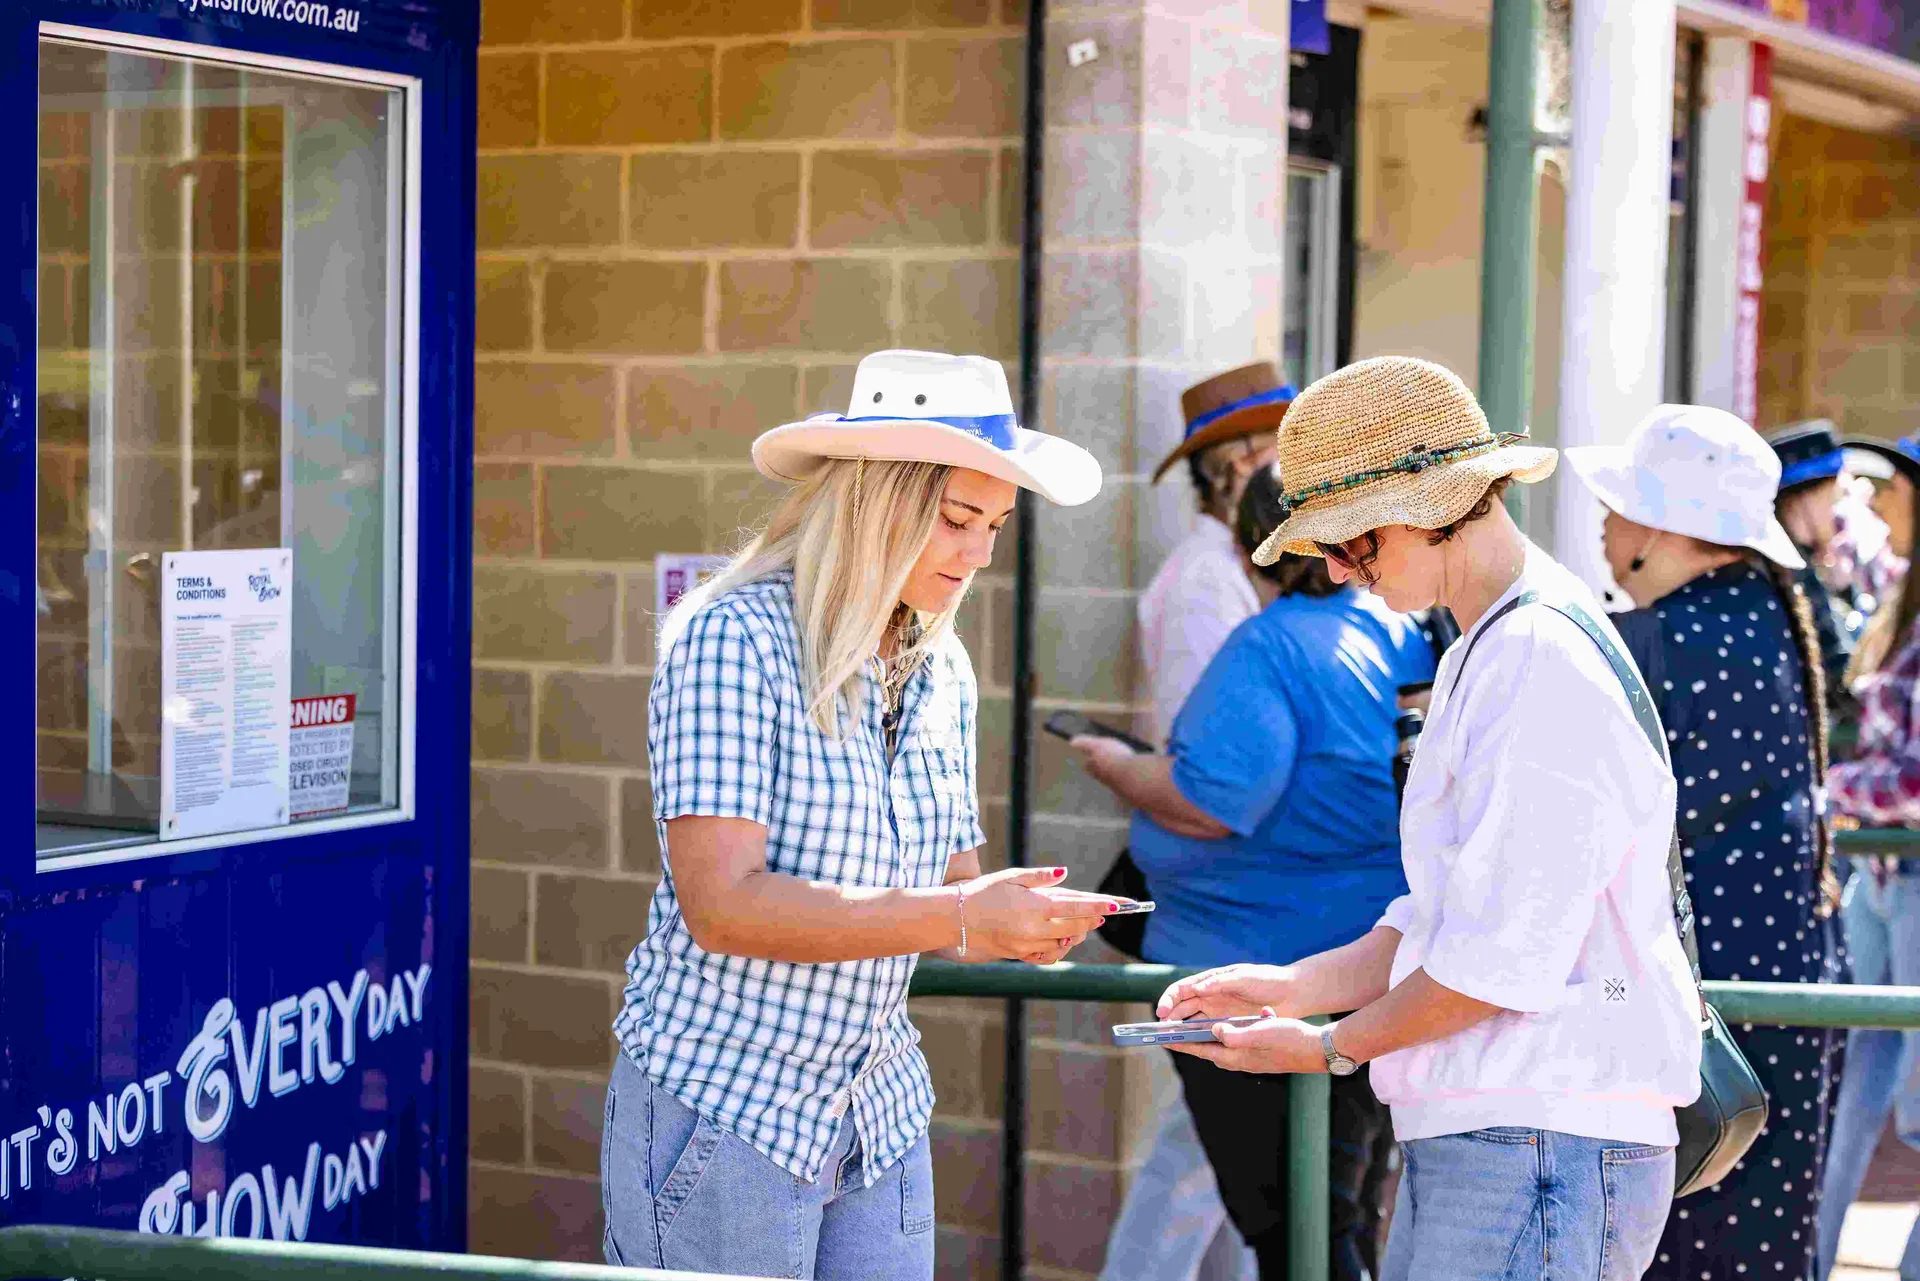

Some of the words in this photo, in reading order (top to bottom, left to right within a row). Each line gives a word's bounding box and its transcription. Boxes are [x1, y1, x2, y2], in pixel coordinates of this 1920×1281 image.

[176, 577, 205, 587] TERMS
[206, 577, 213, 587] &
[176, 588, 226, 601] CONDITIONS
[0, 1104, 77, 1200] IT'S
[88, 1071, 171, 1161] NOT
